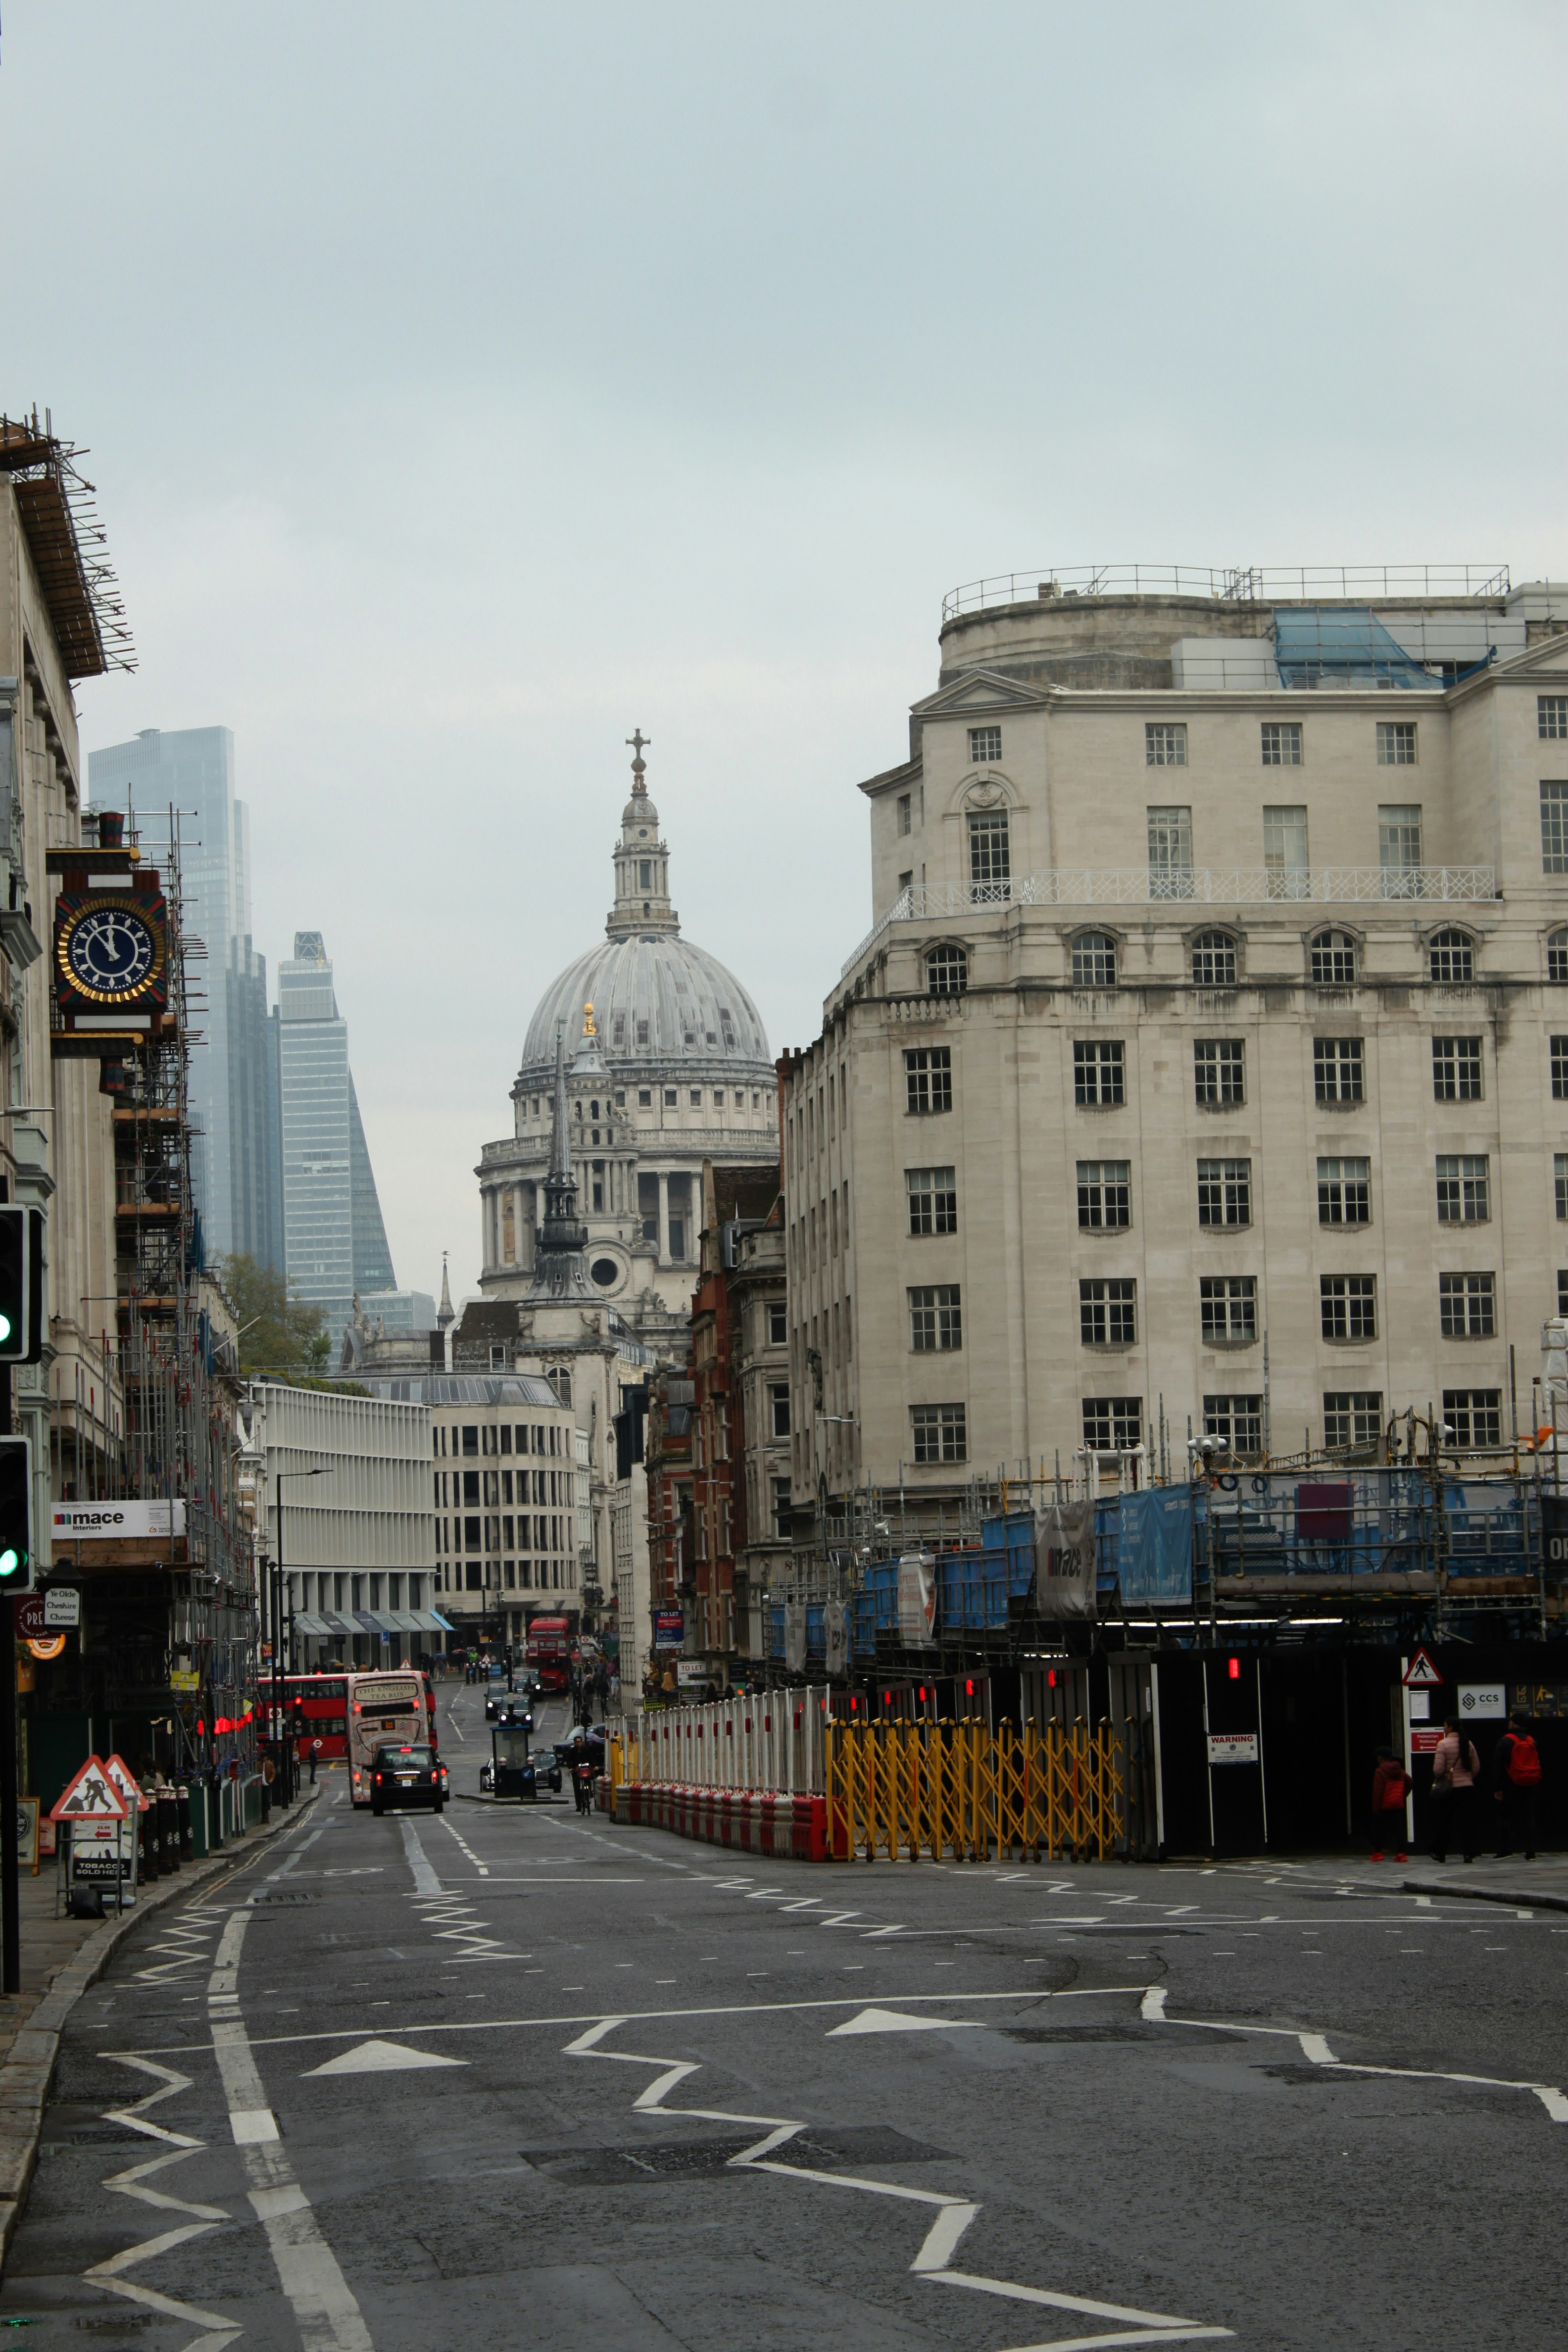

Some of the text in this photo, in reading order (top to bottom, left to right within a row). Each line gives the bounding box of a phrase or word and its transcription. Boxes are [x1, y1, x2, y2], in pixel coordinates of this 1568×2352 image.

[73, 1513, 124, 1524] mace
[20, 1600, 38, 1613] ORGANIC
[27, 1611, 43, 1625] PRE
[19, 1622, 35, 1636] FRESHLY
